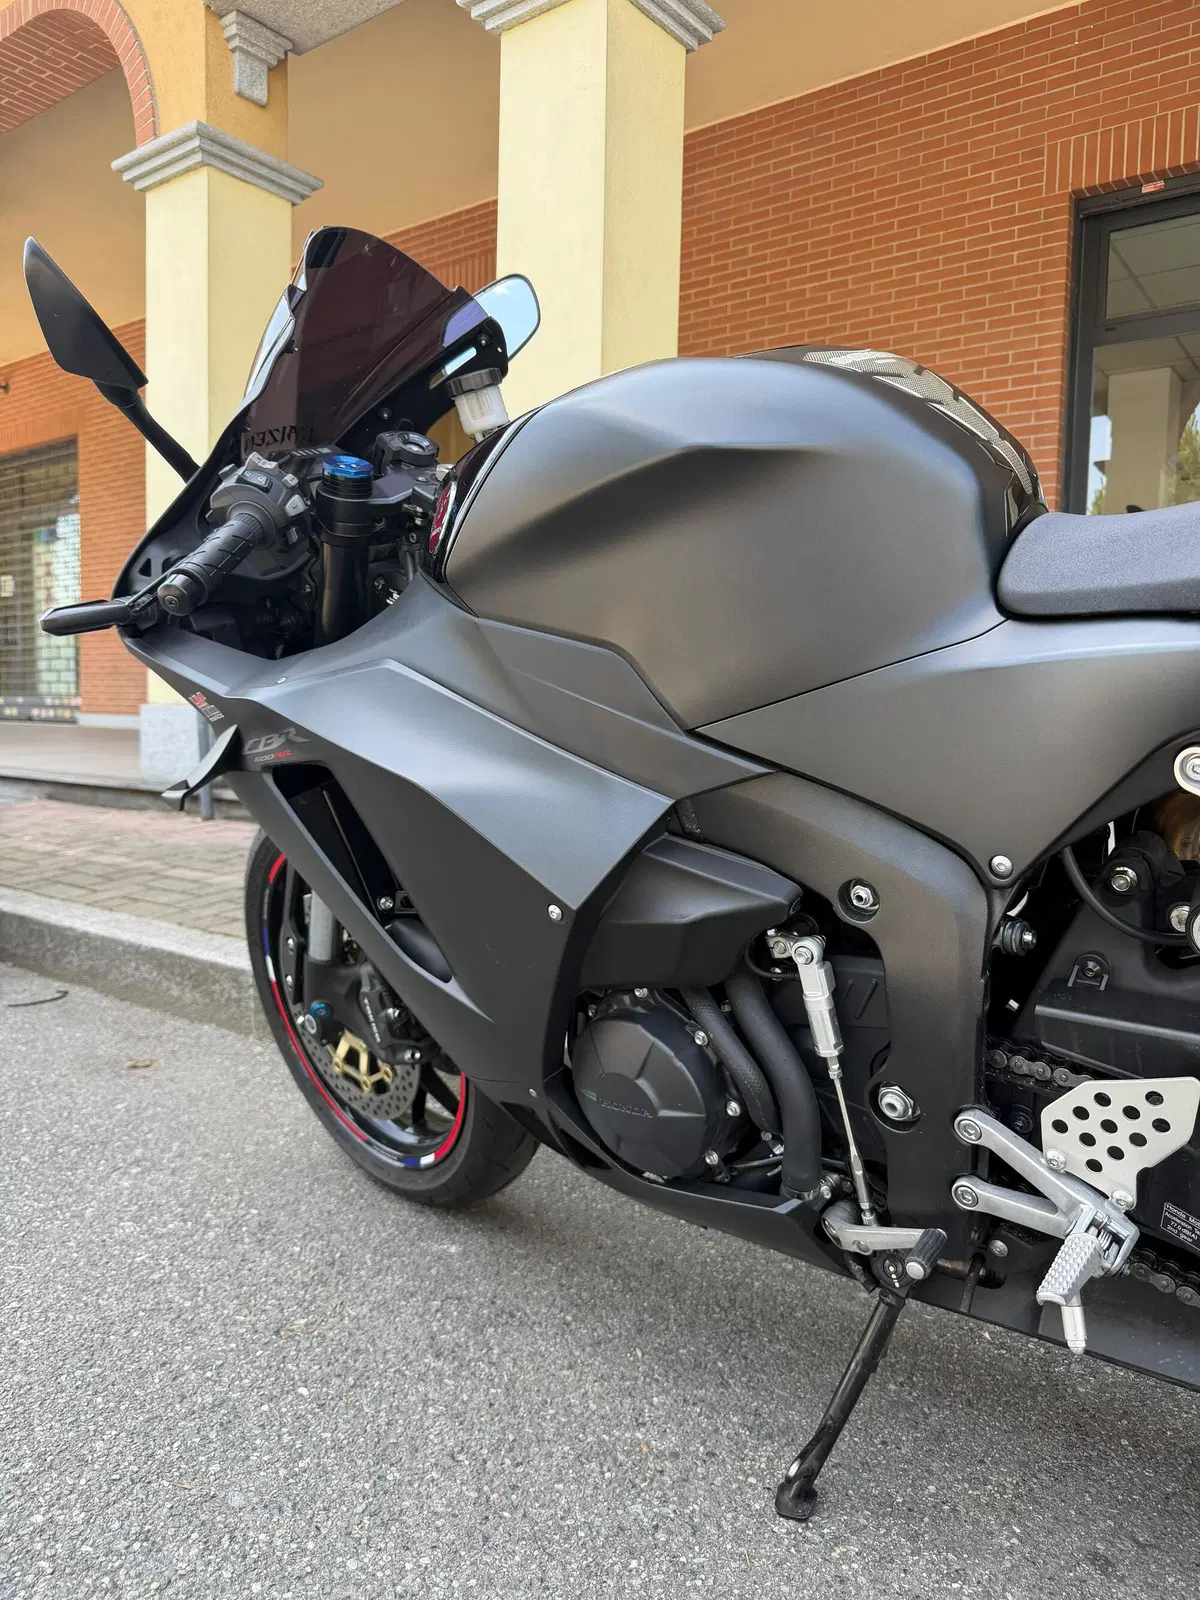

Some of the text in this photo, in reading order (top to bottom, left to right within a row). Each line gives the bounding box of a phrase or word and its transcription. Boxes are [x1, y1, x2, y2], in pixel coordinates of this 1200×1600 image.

[244, 728, 311, 755] CBR
[600, 1098, 654, 1118] HONDA
[1166, 1204, 1186, 1219] Honda
